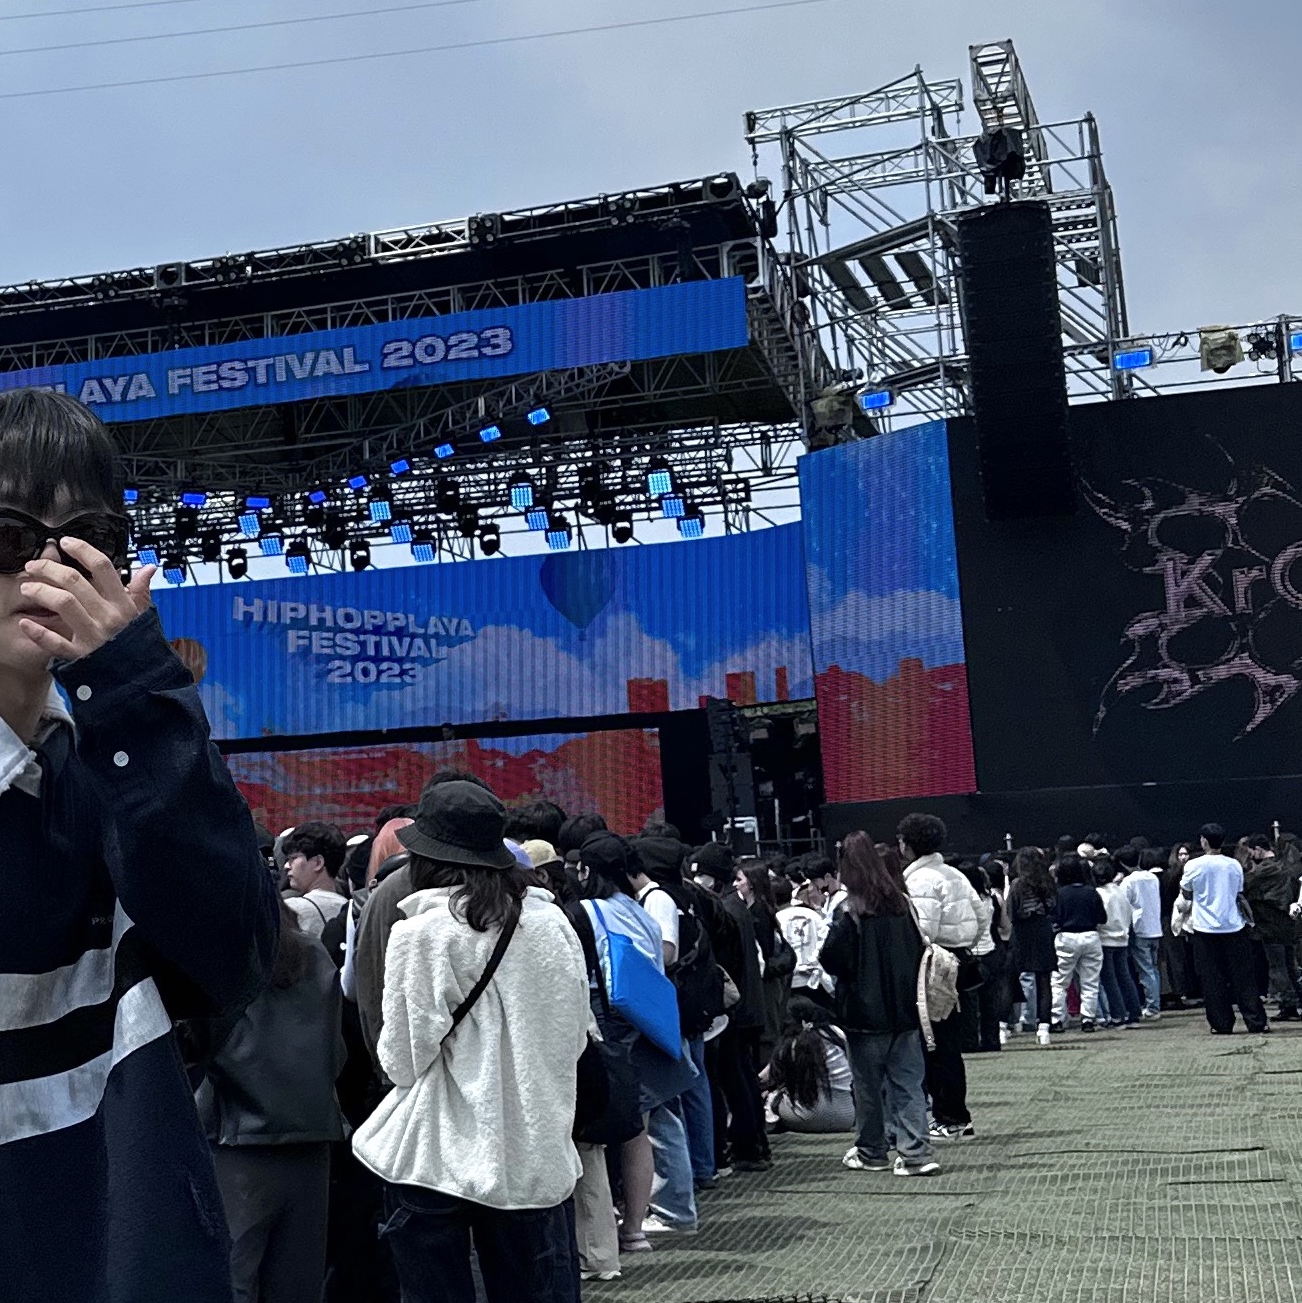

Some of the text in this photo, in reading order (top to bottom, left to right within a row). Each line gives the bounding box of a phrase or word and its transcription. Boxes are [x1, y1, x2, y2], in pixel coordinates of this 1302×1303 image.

[168, 348, 370, 394] FESTIVAL
[383, 327, 513, 368] 2023
[233, 597, 475, 638] HIPHOPPLAYA
[287, 630, 446, 659] FESTIVAL
[327, 659, 422, 684] 2023
